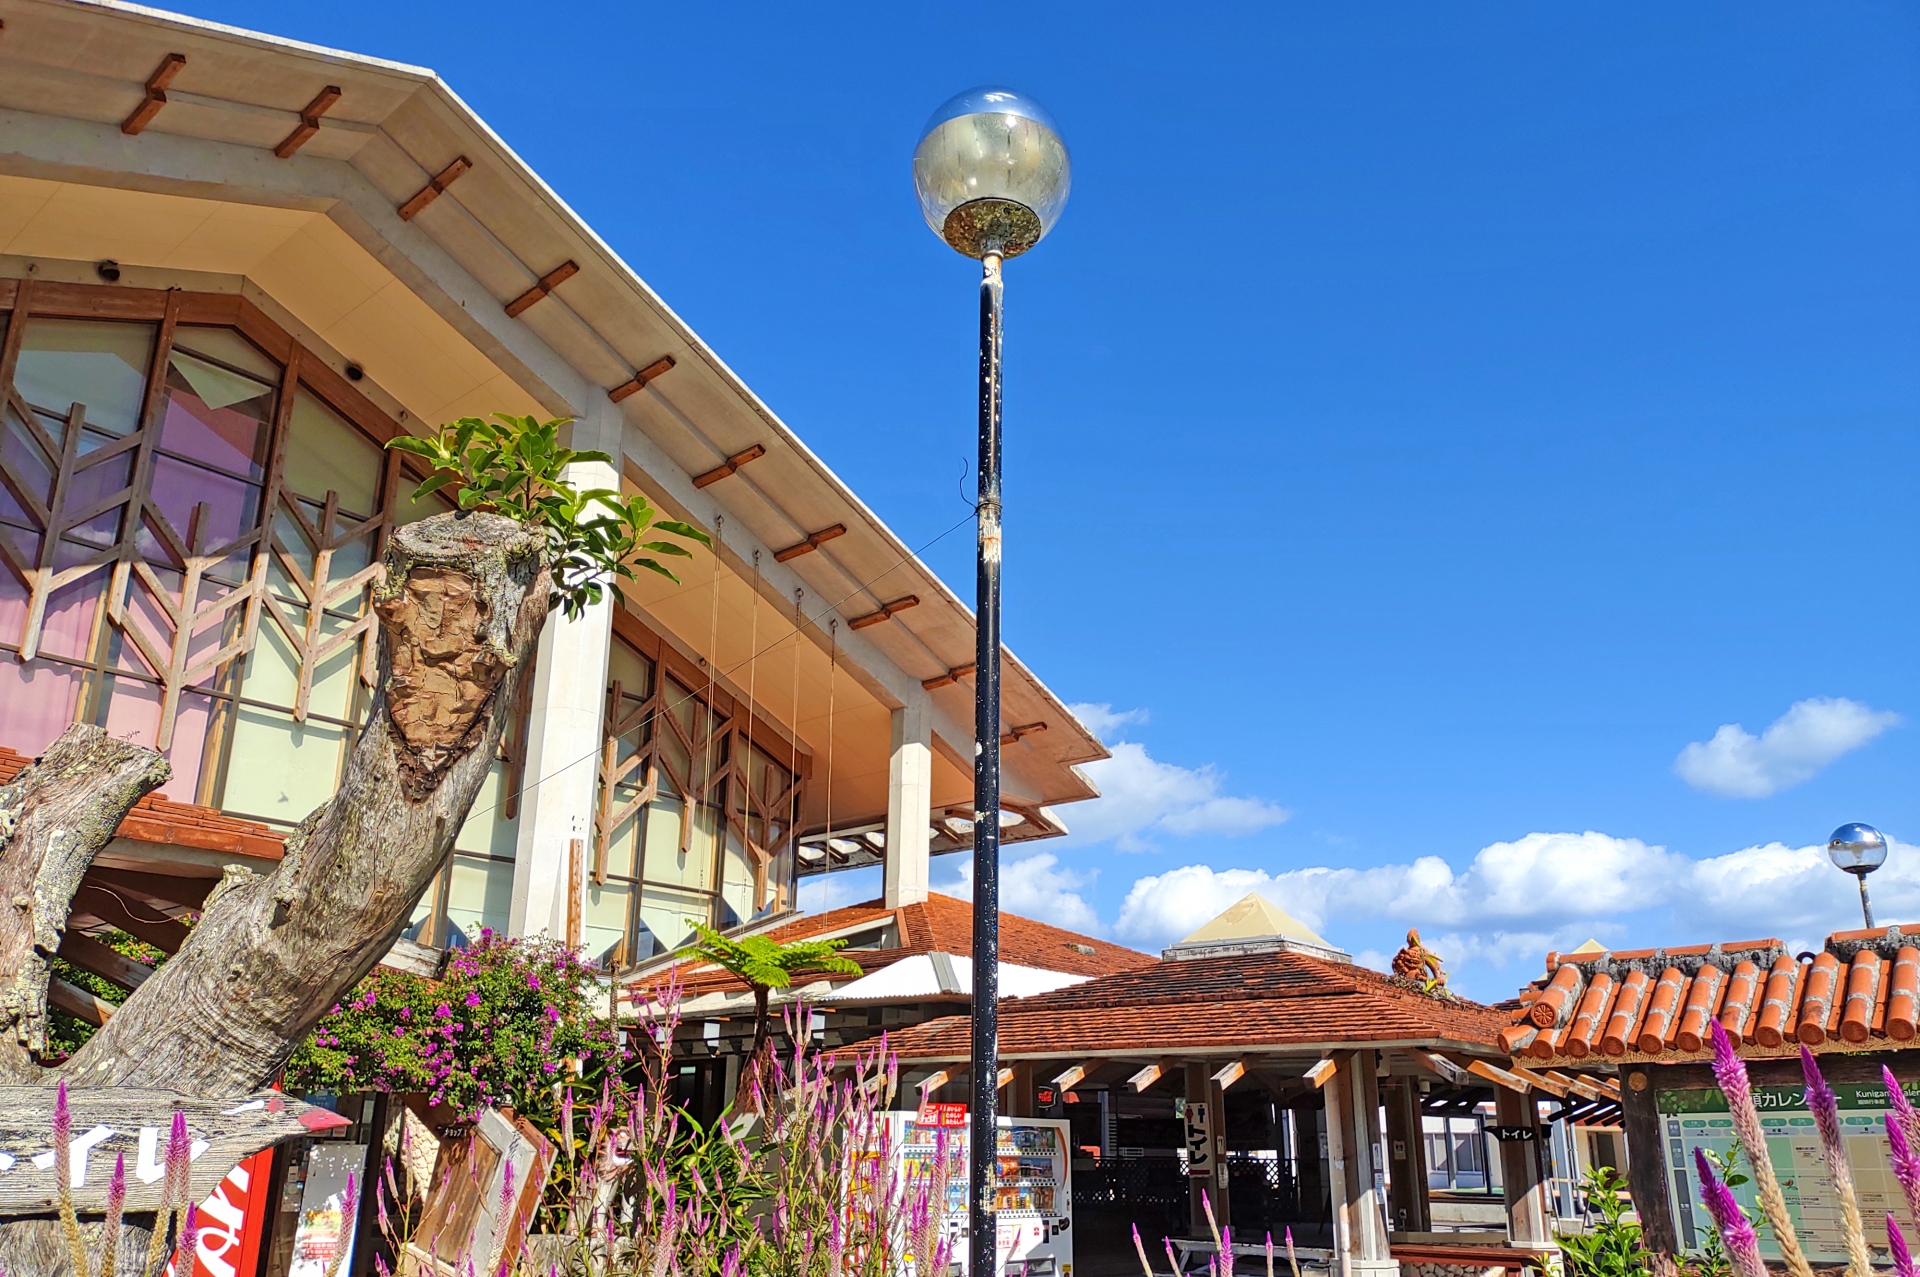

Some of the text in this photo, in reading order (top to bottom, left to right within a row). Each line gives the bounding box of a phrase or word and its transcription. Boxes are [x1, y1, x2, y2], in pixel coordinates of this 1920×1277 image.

[1855, 1089, 1890, 1099] Kunigan
[1187, 1124, 1209, 1165] トイレ
[1502, 1129, 1532, 1139] トイレ
[0, 1124, 211, 1188] イレ
